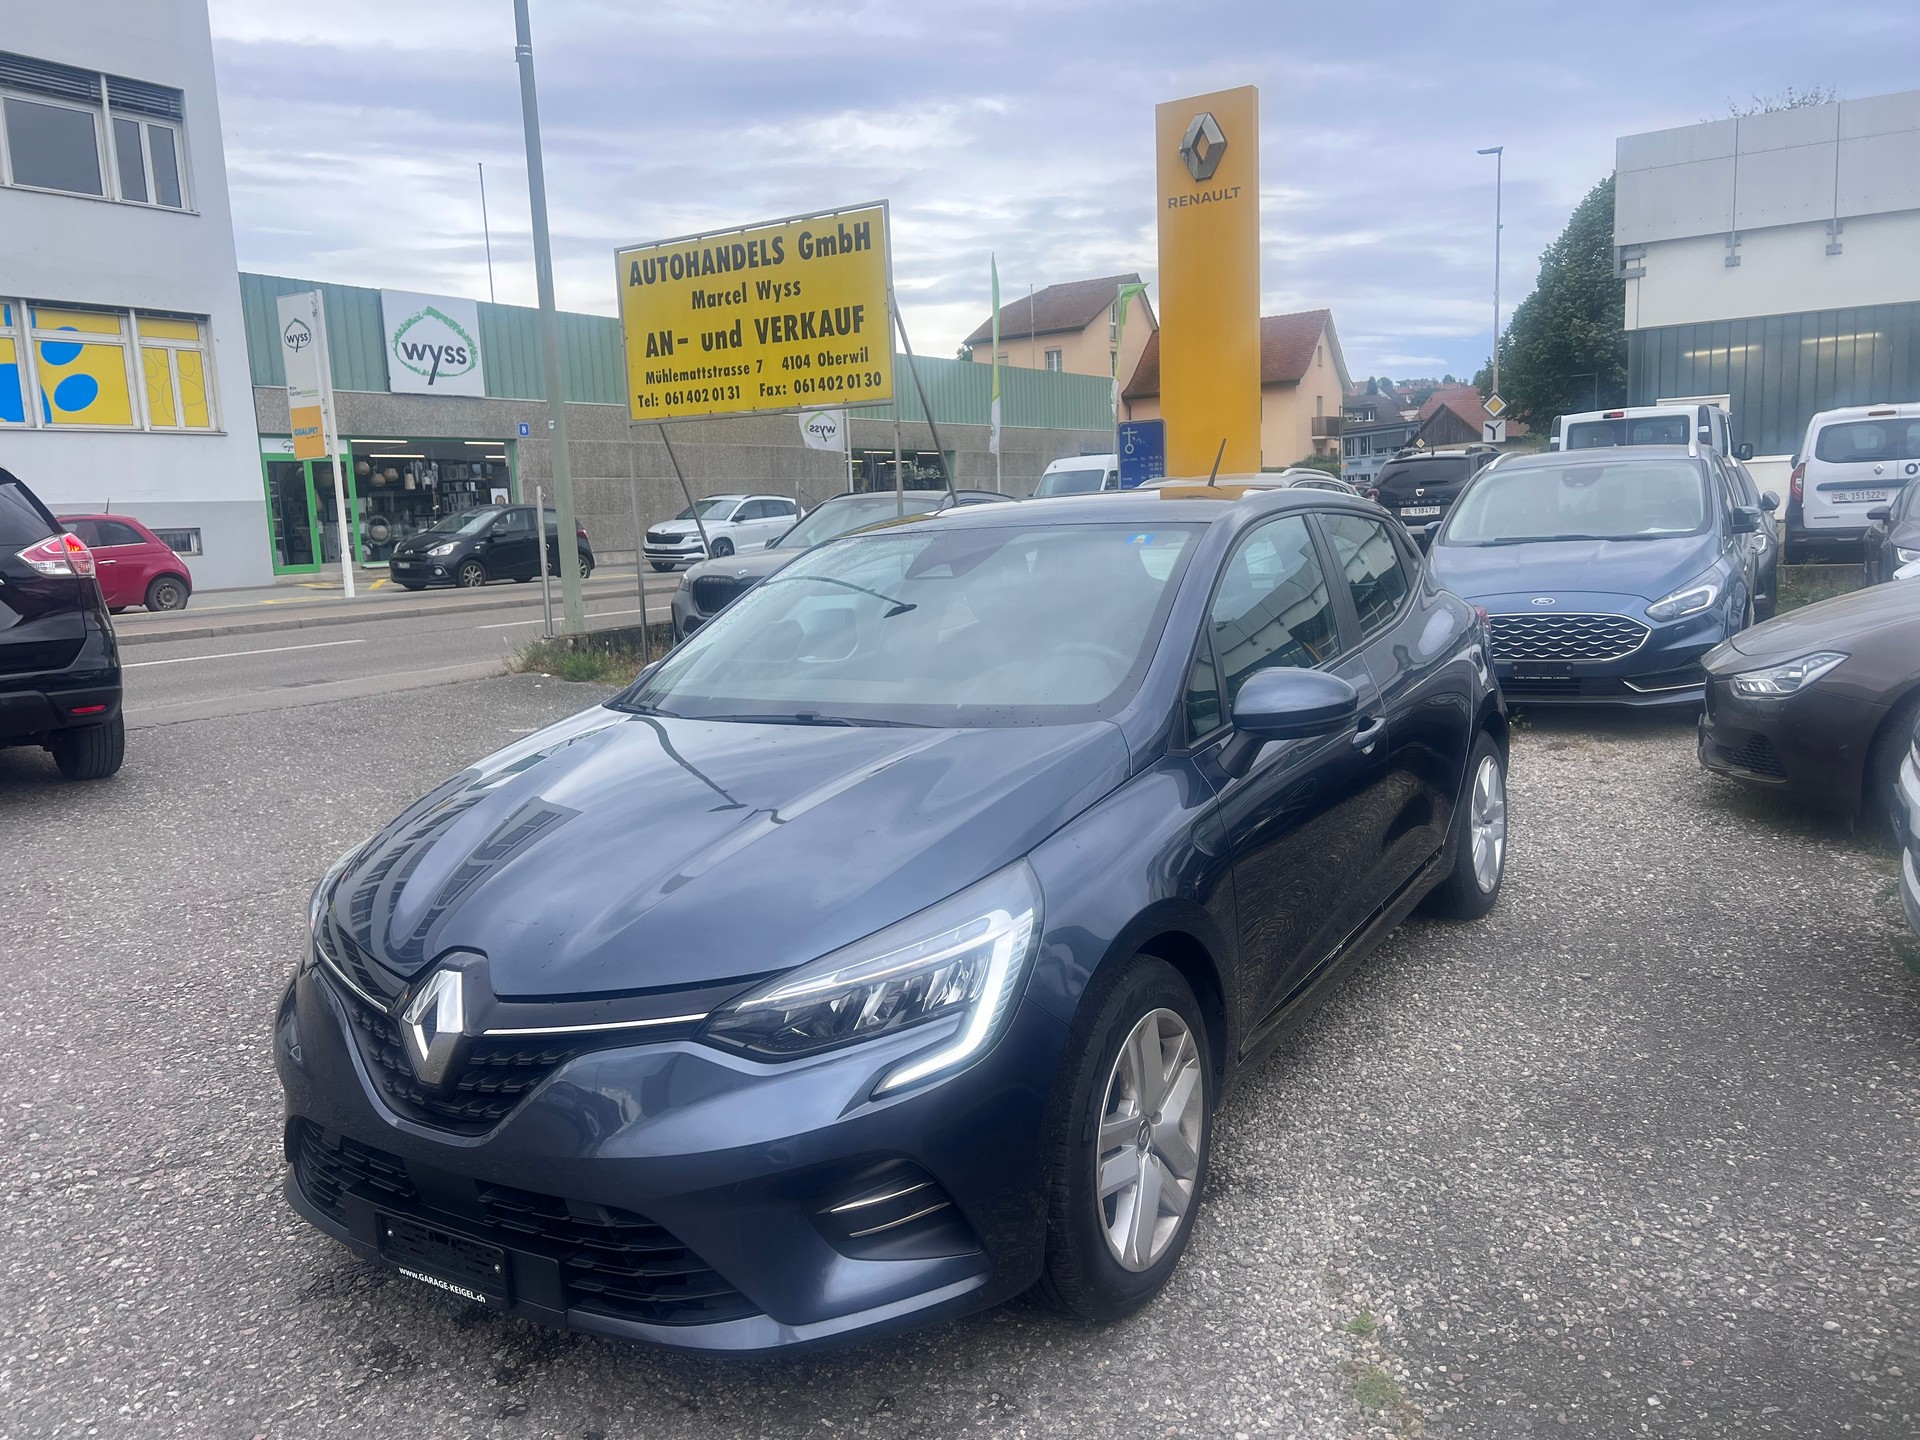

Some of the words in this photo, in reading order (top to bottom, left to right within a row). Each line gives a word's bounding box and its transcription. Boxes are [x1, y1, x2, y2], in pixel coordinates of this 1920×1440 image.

[1168, 186, 1241, 209] RENAULT
[629, 236, 785, 287] AUTOHANDELS
[798, 221, 871, 260] GmbH
[691, 282, 747, 310] Marcel
[755, 279, 801, 303] Wyss
[286, 333, 308, 353] wyss
[701, 319, 743, 351] und
[754, 305, 865, 345] VERKAUF
[401, 342, 467, 385] wyss
[645, 364, 750, 385] Mühlemattstrasse
[755, 359, 763, 374] 7
[782, 354, 811, 370] 4104
[817, 346, 869, 367] Oberwil
[638, 393, 659, 408] Tel:
[759, 382, 787, 397] Fax:
[521, 425, 527, 434] 8
[398, 1266, 486, 1304] www.GARAGE-KEIGEL.ch
